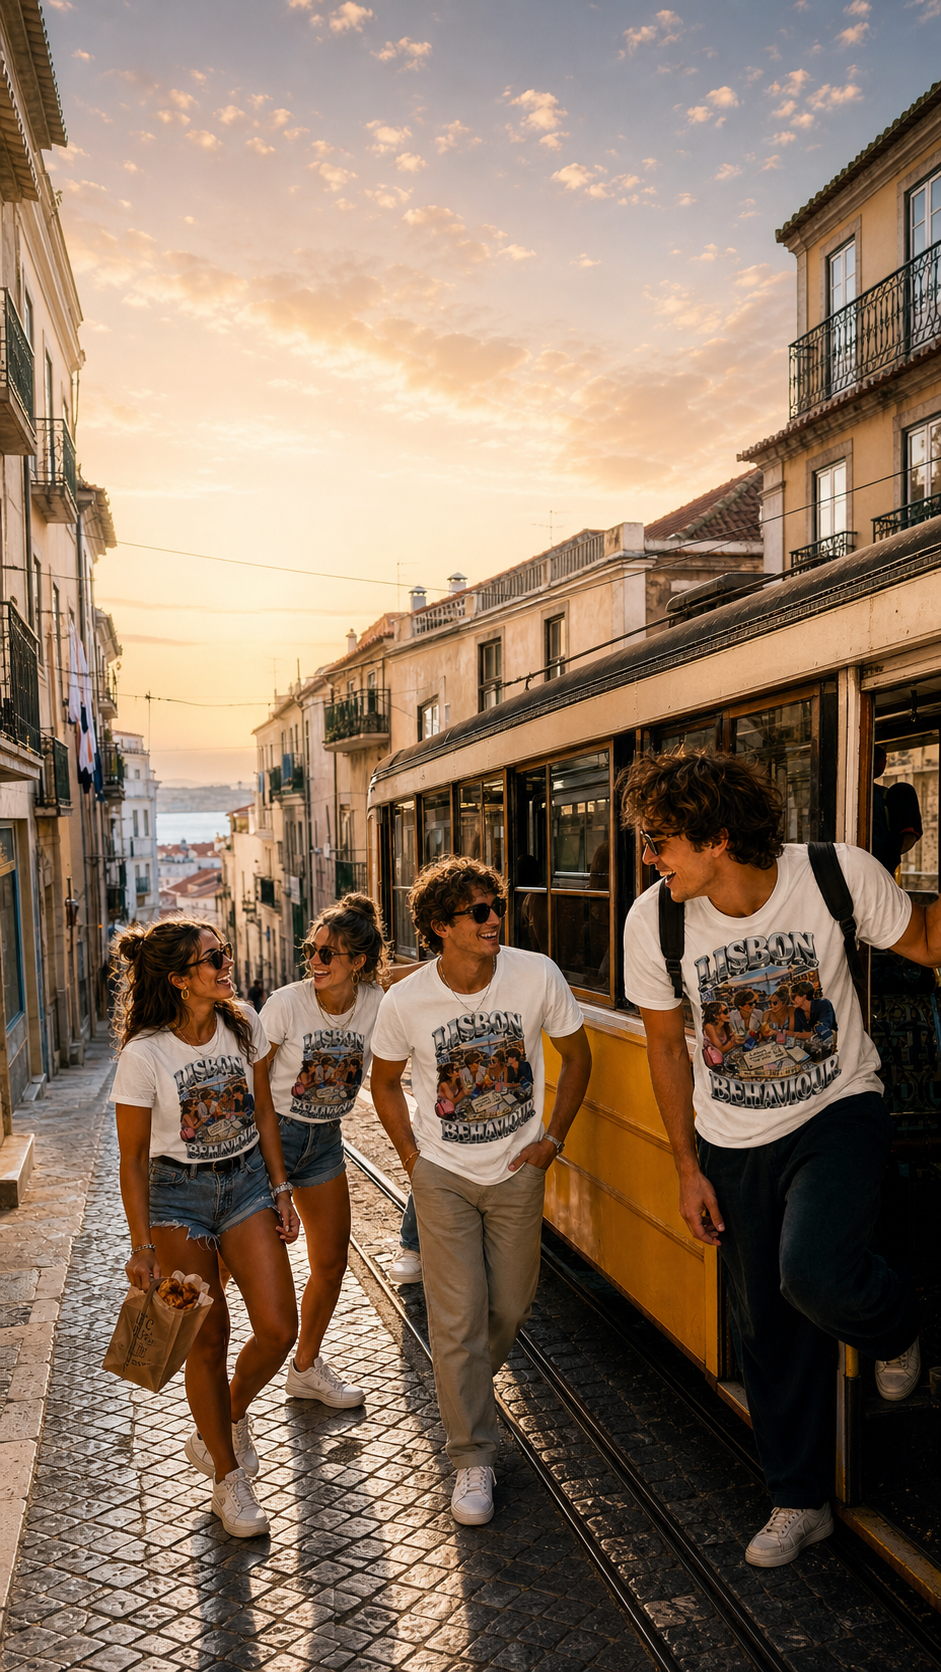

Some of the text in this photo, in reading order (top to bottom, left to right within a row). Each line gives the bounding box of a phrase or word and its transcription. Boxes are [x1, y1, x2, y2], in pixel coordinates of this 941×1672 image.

[694, 931, 819, 992] LISBON
[303, 1028, 365, 1055] LISBON
[432, 1010, 525, 1058] LISBON
[174, 1055, 246, 1094] LISBON
[709, 1054, 842, 1110] BEHAVIOUR
